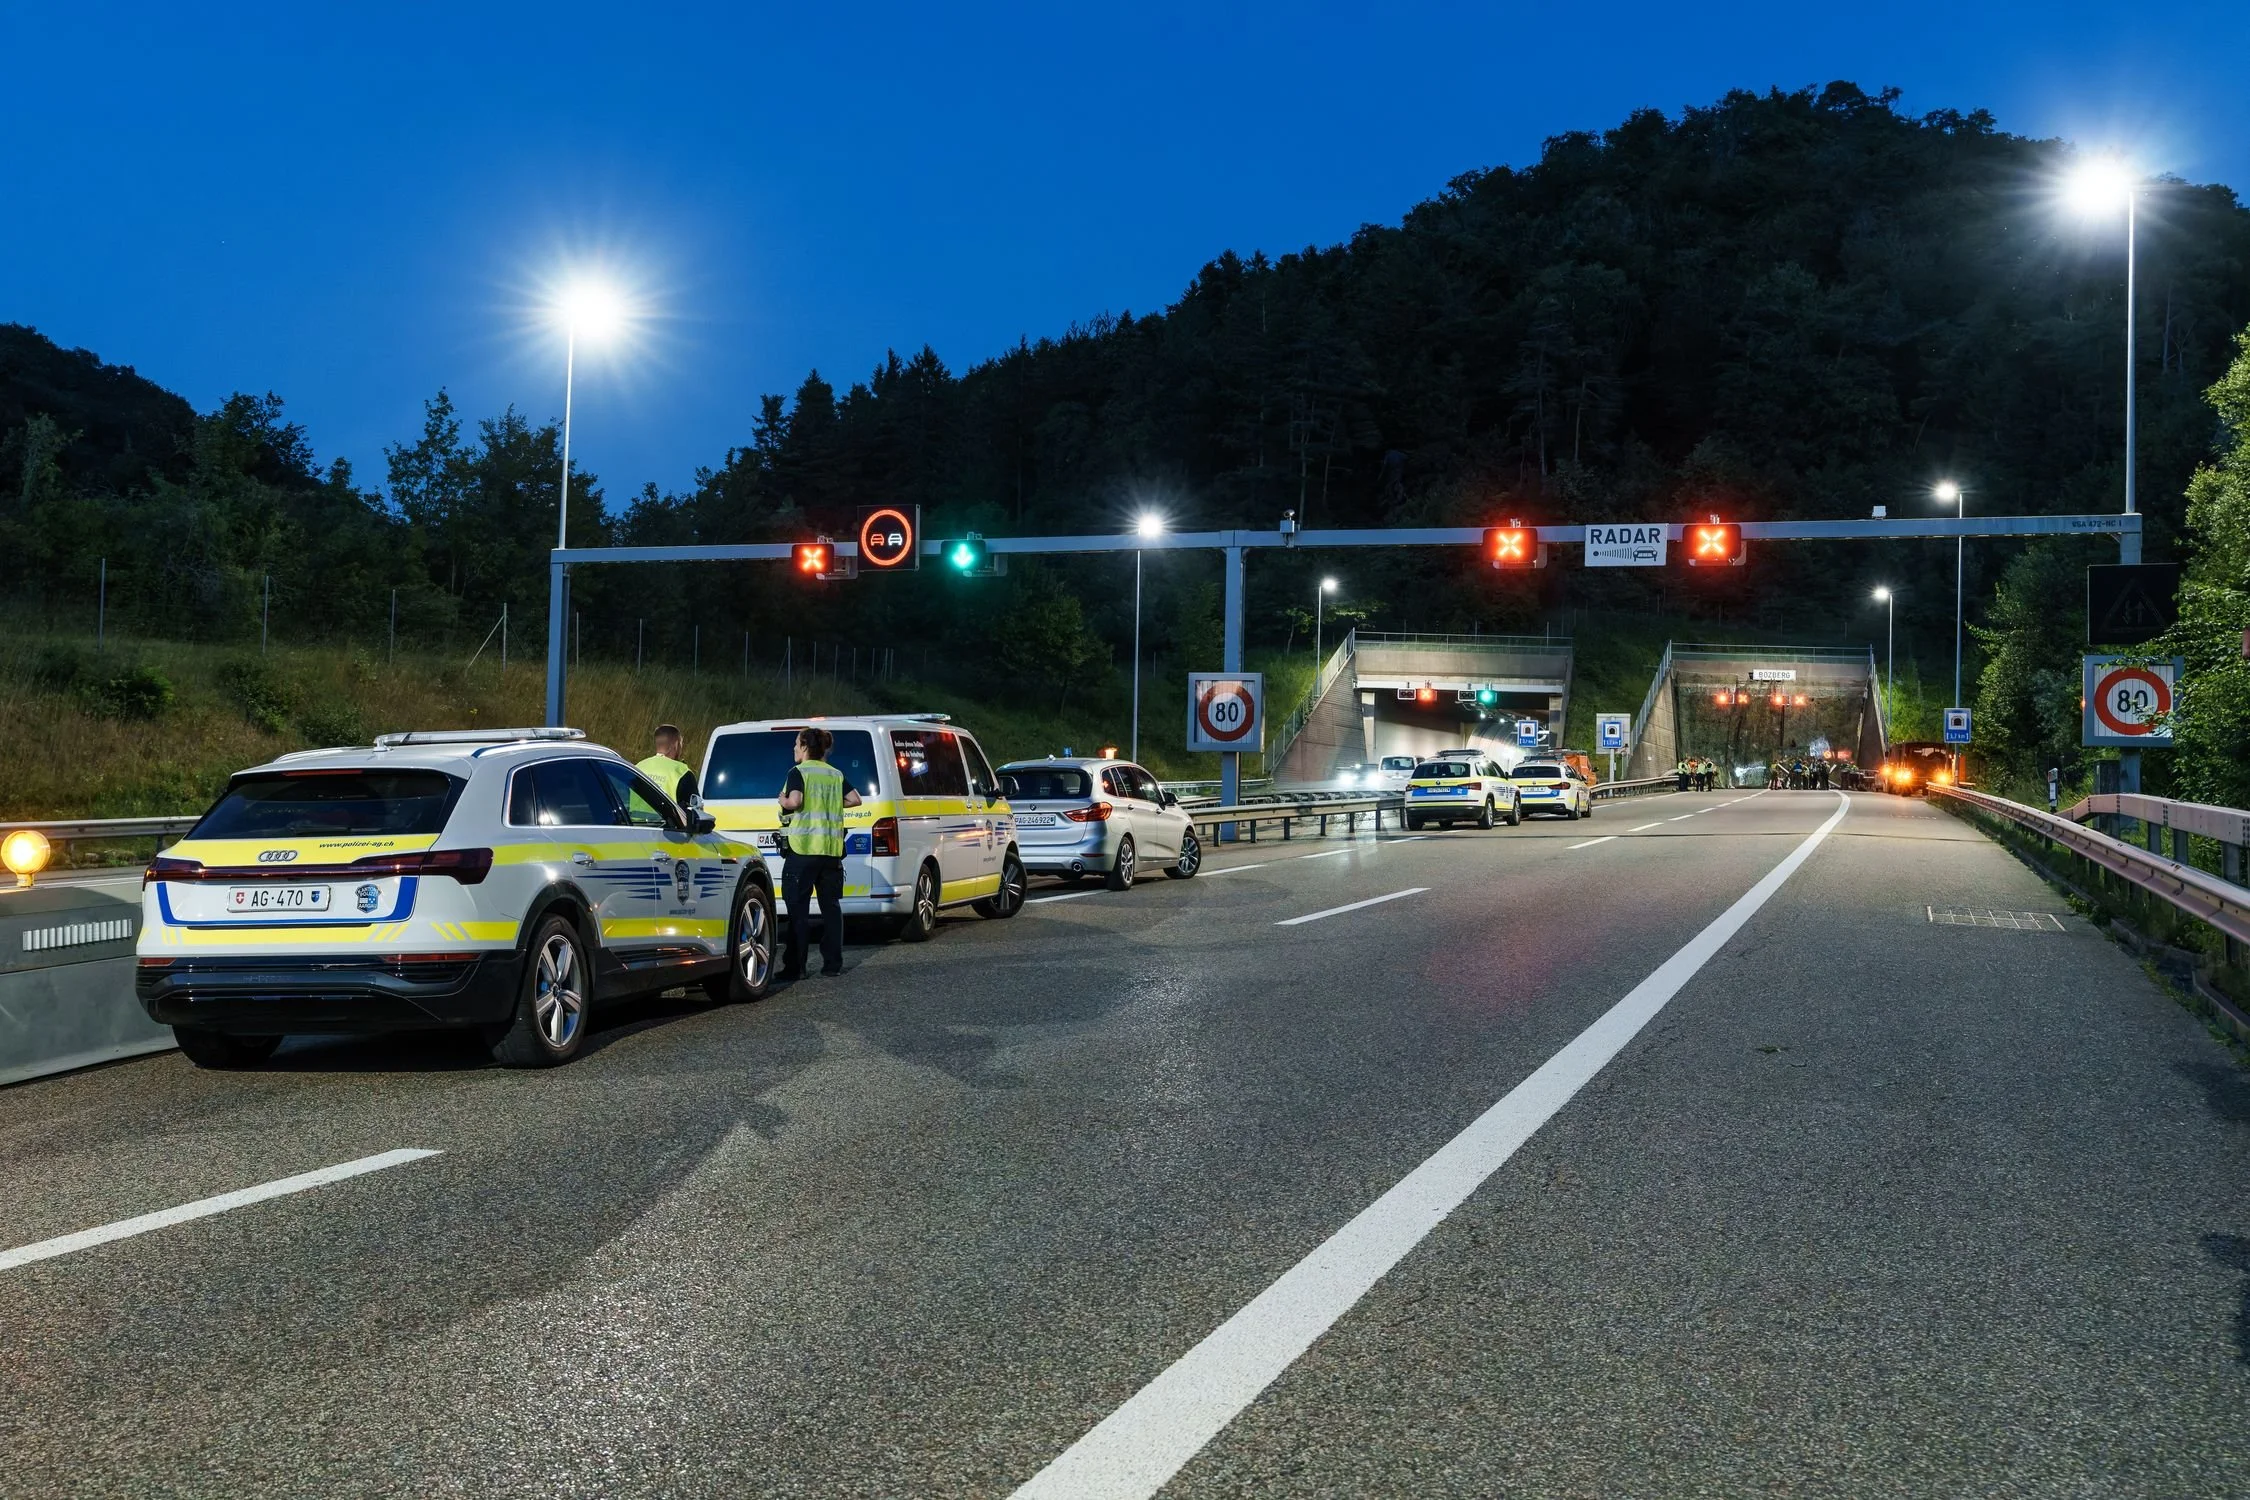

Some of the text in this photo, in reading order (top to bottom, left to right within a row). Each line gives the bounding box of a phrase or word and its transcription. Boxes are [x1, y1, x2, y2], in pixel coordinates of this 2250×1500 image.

[1590, 528, 1660, 544] RADAR
[2117, 689, 2148, 713] 80
[1215, 702, 1239, 722] 80
